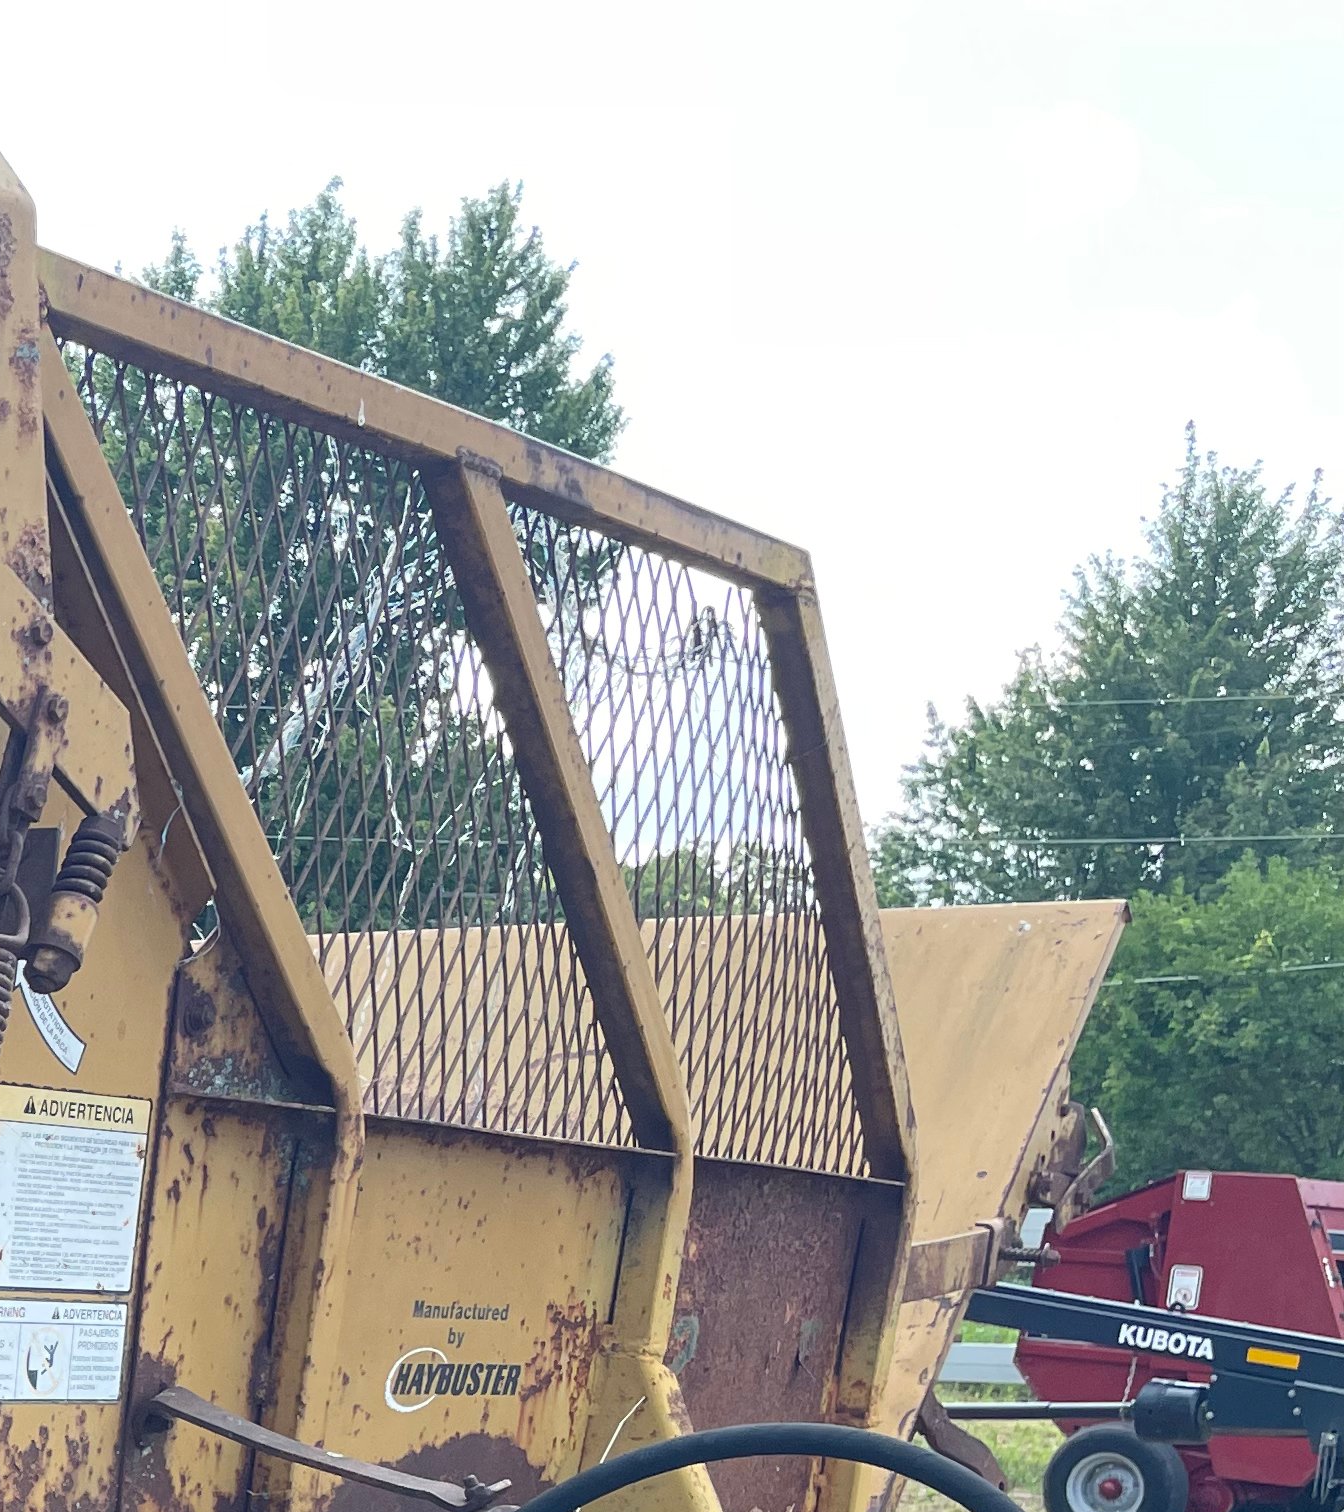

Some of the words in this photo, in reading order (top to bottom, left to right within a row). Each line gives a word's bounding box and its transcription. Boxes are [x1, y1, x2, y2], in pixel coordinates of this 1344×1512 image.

[39, 1098, 135, 1125] ADVERTENCIA
[62, 1308, 123, 1322] ADVERTENCIA
[413, 1300, 510, 1321] Manufactured
[447, 1327, 465, 1348] by
[1118, 1323, 1214, 1361] KUBOTA
[392, 1363, 521, 1396] HAYBUSTER
